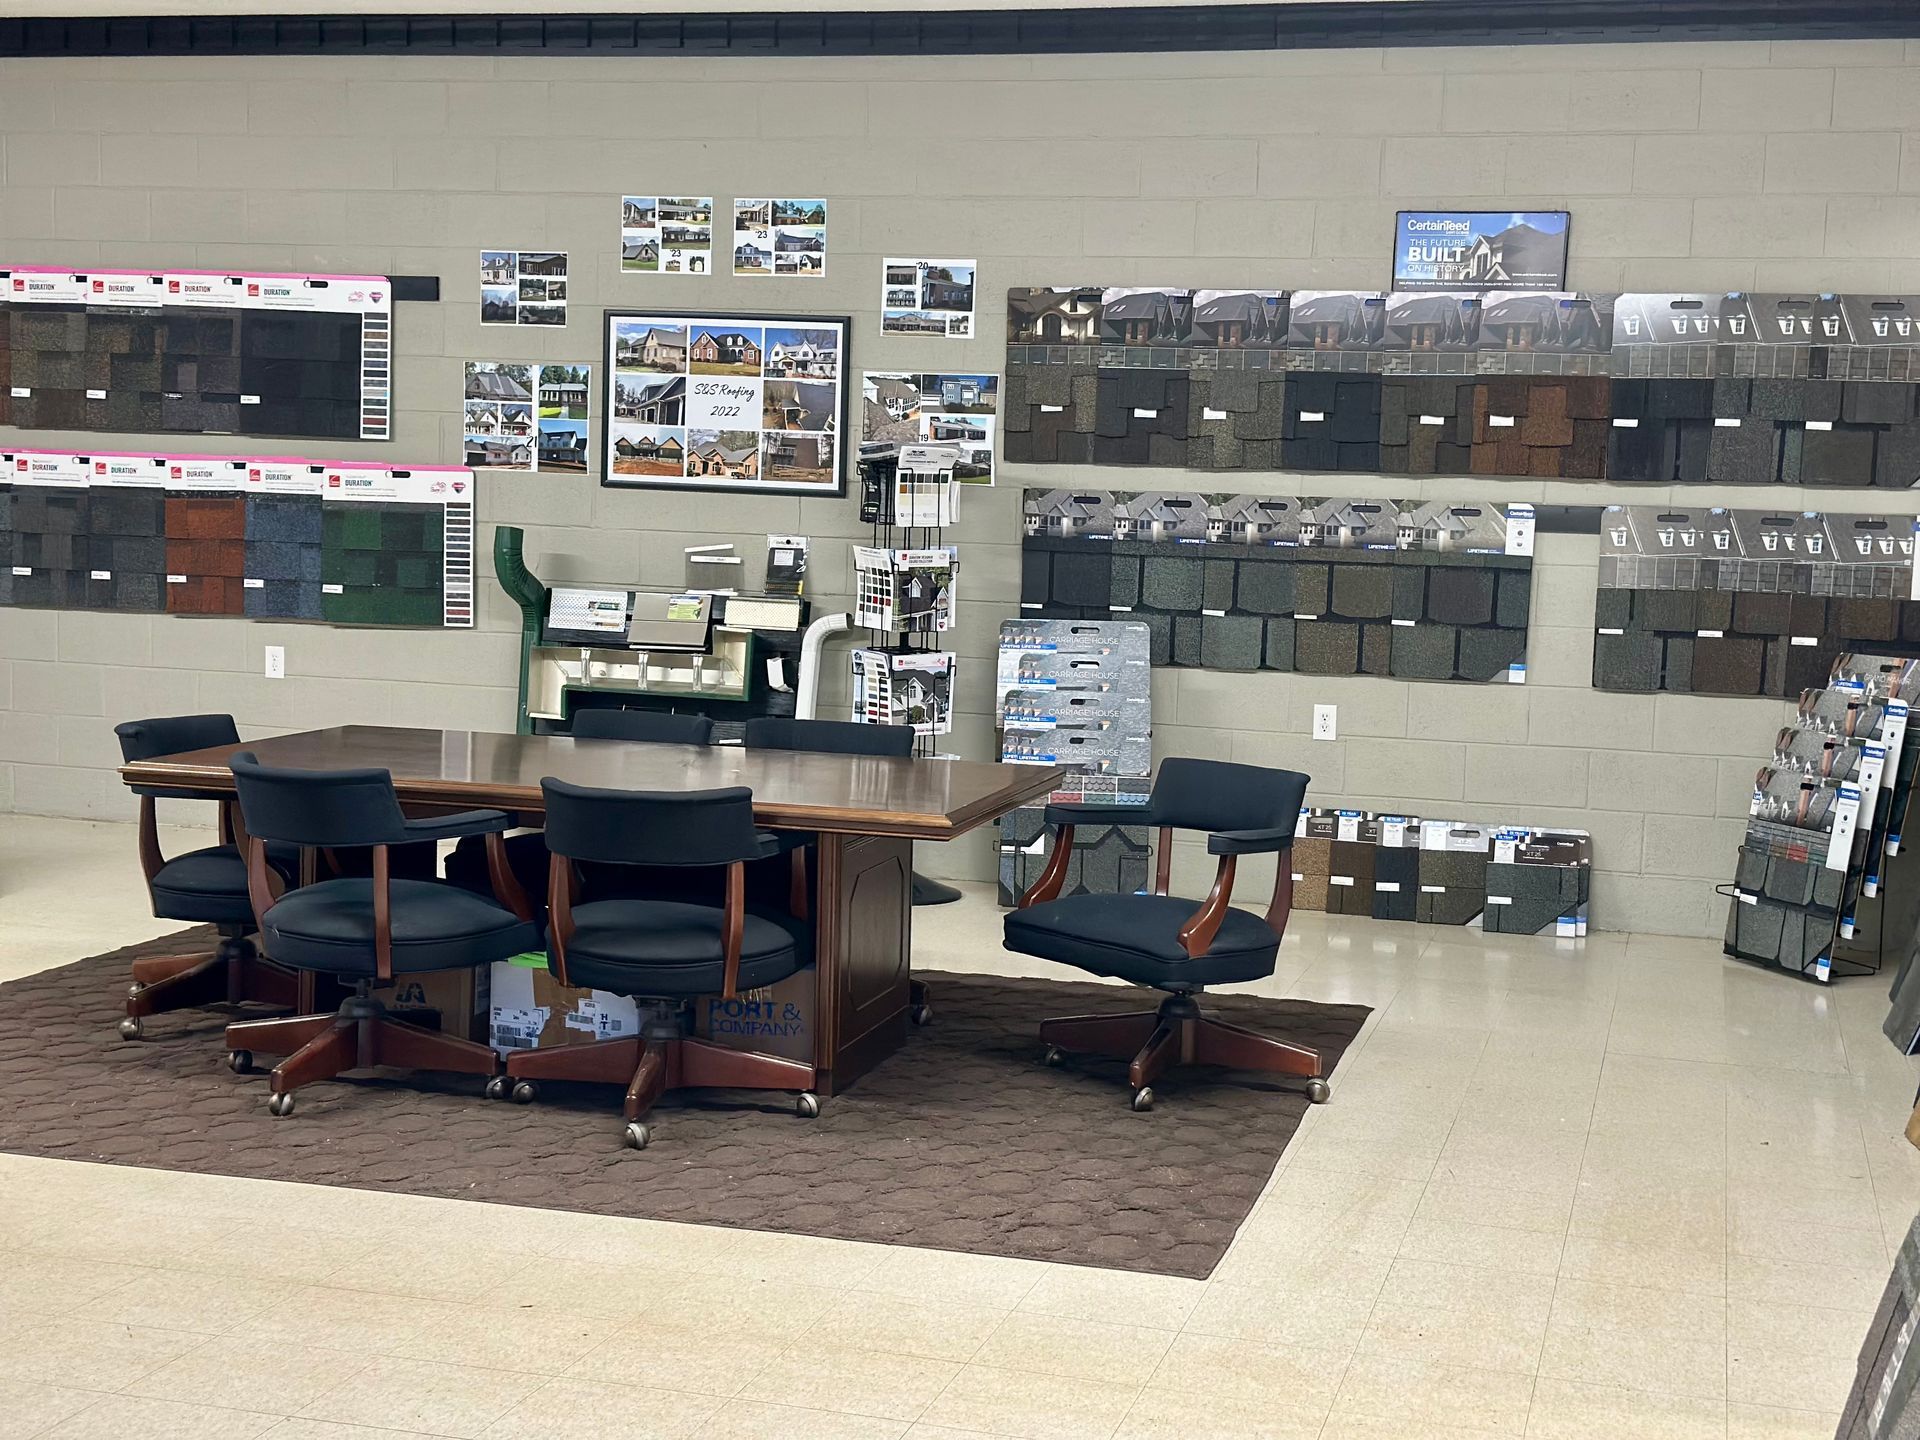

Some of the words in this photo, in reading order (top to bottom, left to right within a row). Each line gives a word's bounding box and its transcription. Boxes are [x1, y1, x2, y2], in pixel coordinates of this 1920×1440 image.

[1407, 219, 1470, 231] CertainTeed
[1409, 238, 1428, 247] THE
[1430, 238, 1466, 247] FUTURE
[1407, 246, 1466, 262] BUILT
[1407, 264, 1421, 272] ON
[1424, 264, 1465, 272] HISTORY
[184, 285, 211, 293] DURATION
[263, 288, 290, 296] DURATION
[719, 384, 755, 402] Roofing
[710, 405, 741, 417] 2022
[186, 470, 213, 478] DURATION
[265, 473, 292, 481] DURATION
[345, 479, 372, 487] DURATION
[1091, 637, 1119, 645] HOUSE
[1048, 670, 1090, 678] CARRIAGE
[1091, 671, 1121, 680] HOUSE
[1048, 708, 1090, 716] CARRIAGE
[1091, 709, 1121, 718] HOUSE
[1047, 747, 1090, 755] CARRIAGE
[1091, 749, 1121, 757] HOUSE
[709, 1000, 778, 1019] PORT
[782, 1002, 802, 1021] &
